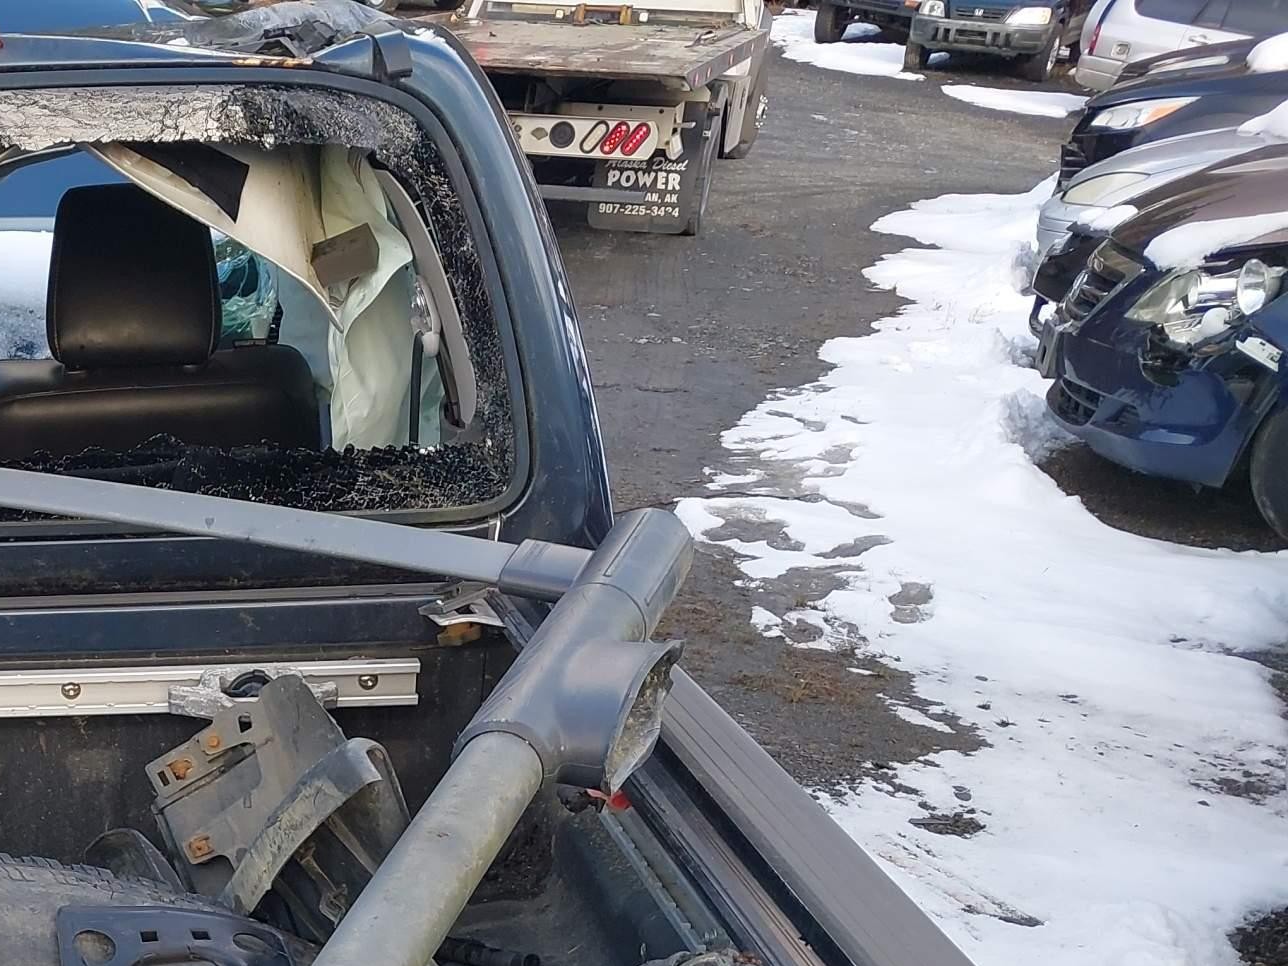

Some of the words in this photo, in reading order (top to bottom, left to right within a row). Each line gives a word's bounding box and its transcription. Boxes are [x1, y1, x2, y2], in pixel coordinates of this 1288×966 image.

[652, 156, 689, 171] Diesel
[607, 168, 681, 191] POWER
[664, 193, 679, 204] AK
